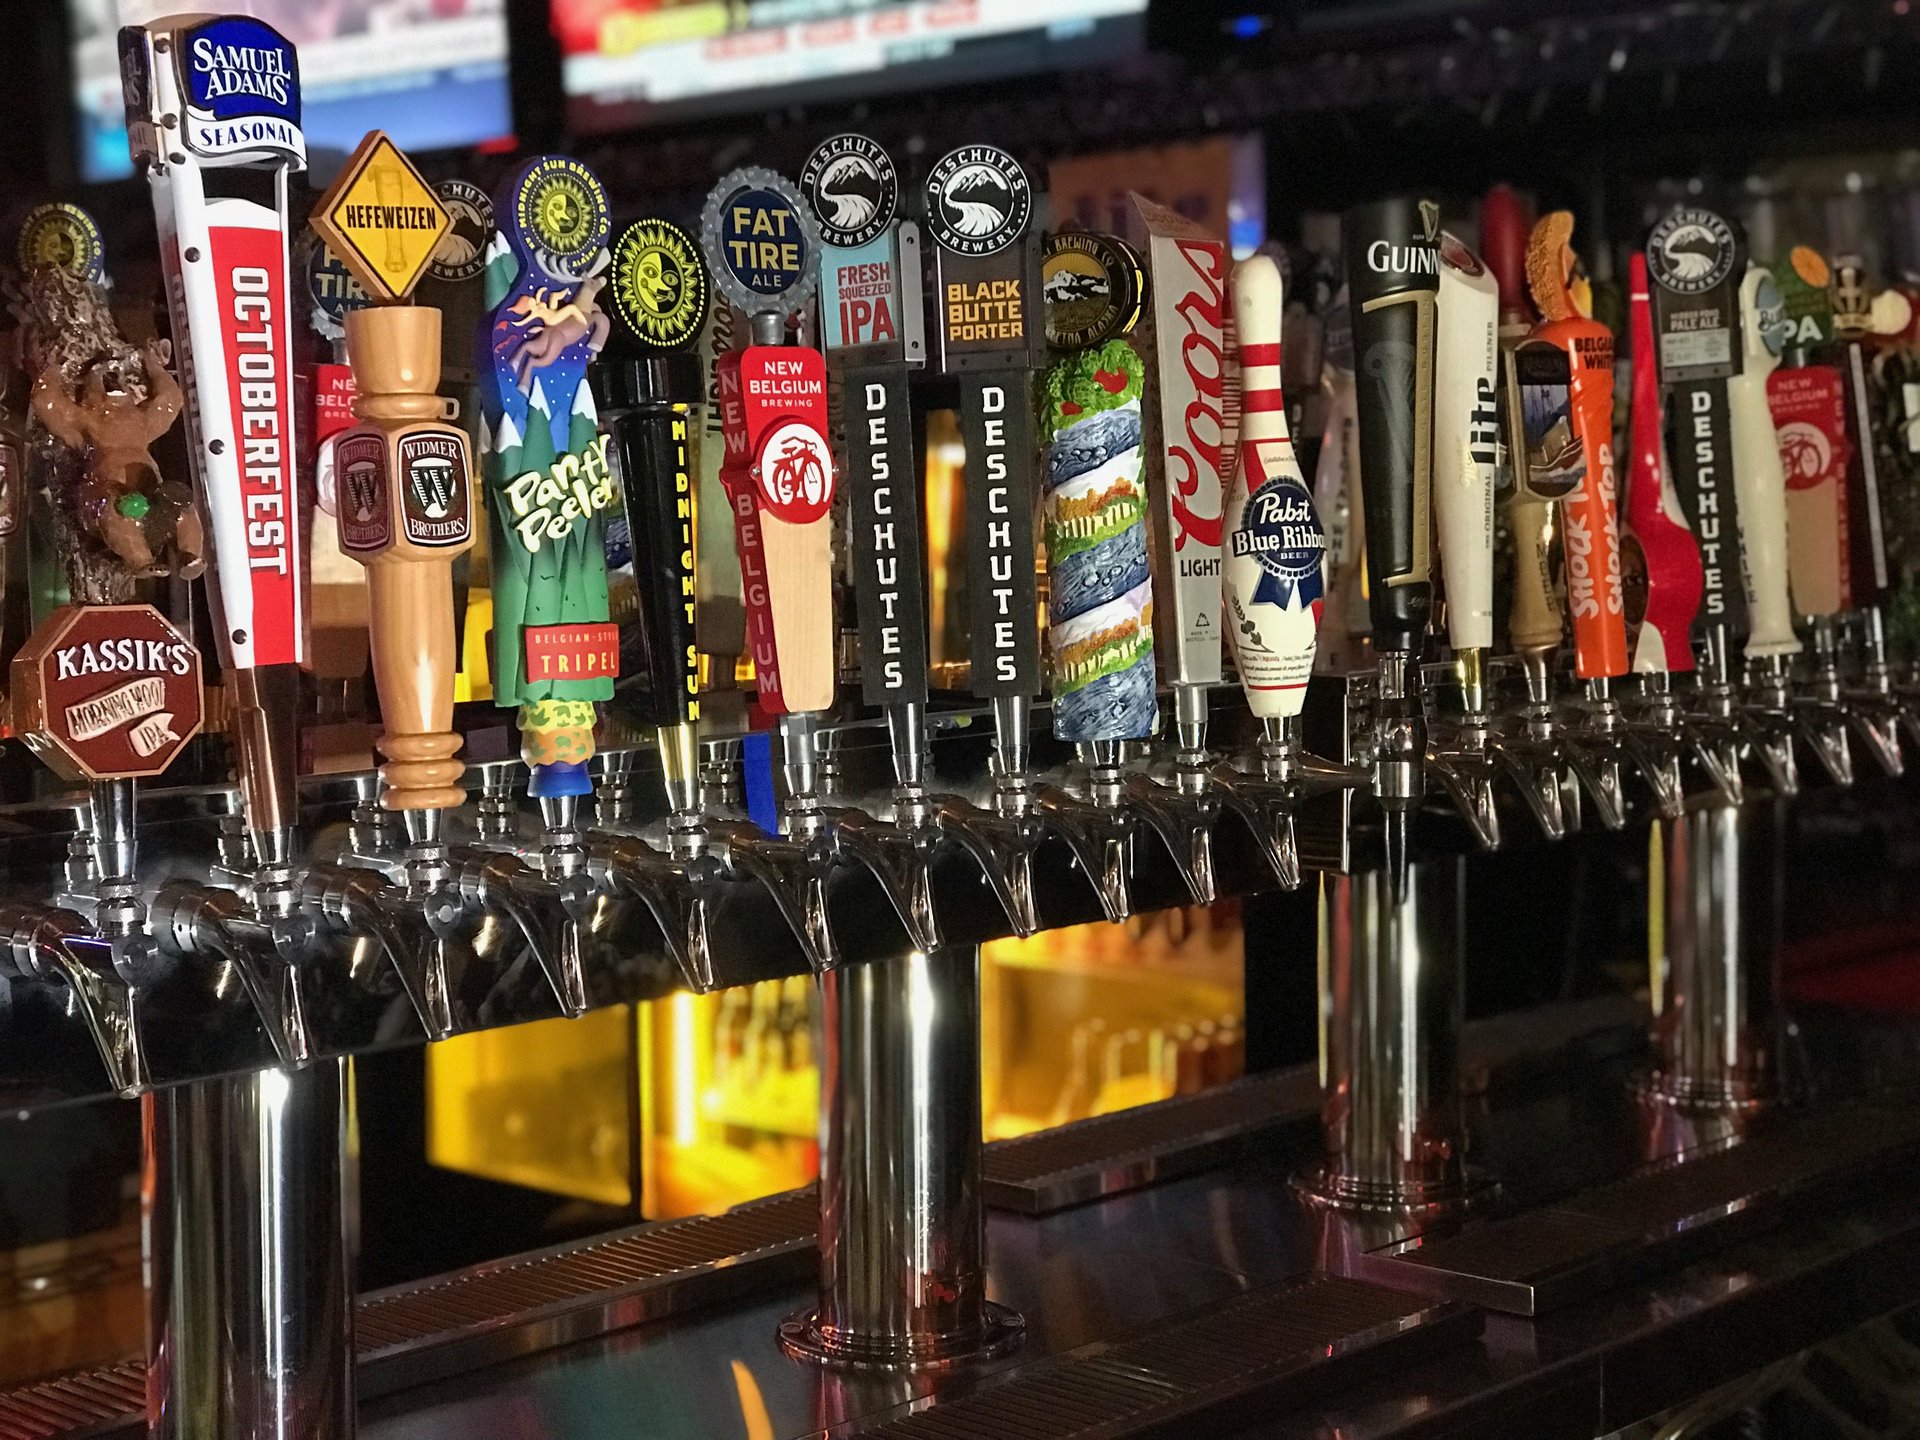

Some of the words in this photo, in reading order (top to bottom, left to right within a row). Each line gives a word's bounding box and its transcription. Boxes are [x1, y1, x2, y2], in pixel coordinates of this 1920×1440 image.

[193, 38, 291, 80] SAMUEL
[205, 69, 288, 106] ADAMS
[200, 122, 295, 147] SEASONAL
[804, 137, 893, 185] DESCHUTES
[928, 148, 1026, 194] DESCHUTES
[440, 184, 495, 228] CHUTES
[518, 166, 541, 228] MIDNIGHT
[543, 160, 566, 171] SUN
[569, 162, 607, 213] BREWING
[345, 205, 437, 230] HEFEWEIZEN
[732, 206, 790, 236] FAT
[1653, 213, 1730, 247] DESCHUTES
[433, 259, 481, 277] EWERY
[728, 240, 800, 271] TIRE
[1367, 240, 1440, 275] GUINN
[315, 272, 372, 301] TIR
[751, 274, 782, 288] ALE
[837, 262, 890, 286] FRESH
[1661, 271, 1720, 290] BREWERY
[839, 282, 891, 300] SQUEEZED
[947, 280, 1021, 302] BLACK
[839, 297, 896, 346] IPA
[949, 300, 1022, 323] BUTTE
[1670, 319, 1698, 331] PALE
[1700, 317, 1720, 328] ALE
[950, 321, 1023, 341] PORTER
[1782, 315, 1823, 345] PA
[764, 361, 803, 376] NEW
[1584, 354, 1612, 369] WHIT
[332, 378, 356, 392] NE
[750, 380, 821, 394] BELGIUM
[1168, 239, 1224, 552] Coors
[1777, 378, 1812, 391] NEW
[761, 399, 813, 407] BREWING
[231, 266, 287, 576] OCTOBERFEST
[404, 441, 458, 460] WIDMER
[505, 434, 611, 516] Party
[1597, 443, 1616, 510] TOP
[516, 476, 615, 553] Peeler
[1255, 492, 1311, 525] Pabst
[1484, 474, 1492, 532] ORIGINAL
[1691, 391, 1724, 615] DESCHUTES
[410, 517, 465, 537] BROTHERS
[721, 371, 747, 454] NEW
[736, 493, 779, 694] BELGIUM
[865, 383, 903, 688] DESCHUTES
[982, 386, 1018, 682] DESCHUTES
[1234, 530, 1280, 555] Blue
[1281, 526, 1325, 549] Ribbo
[672, 419, 696, 624] MIDNIGHT
[686, 645, 701, 720] SUN
[1180, 558, 1221, 577] LIGHT
[1280, 551, 1309, 560] BEER
[1566, 513, 1599, 619] SHOCK
[1603, 513, 1624, 614] SHOCK
[57, 639, 190, 681] KASSIK'S
[541, 653, 616, 673] TRIPEL
[68, 691, 135, 736] MORNING
[138, 722, 169, 751] IPA
